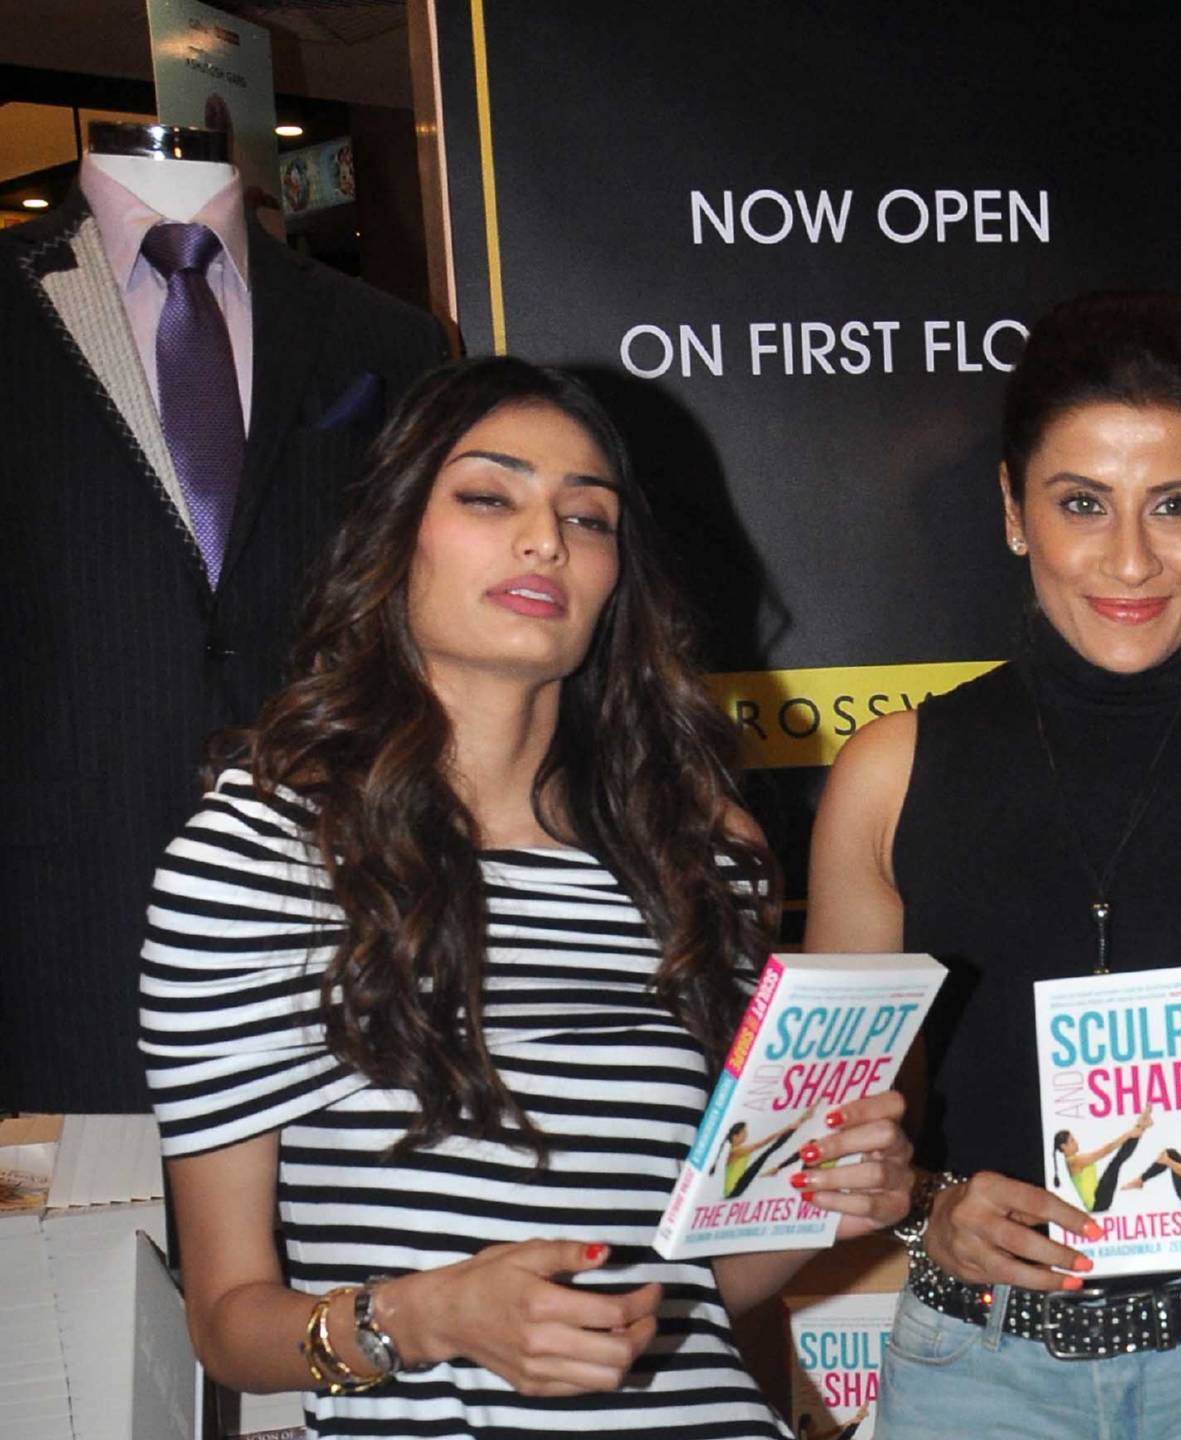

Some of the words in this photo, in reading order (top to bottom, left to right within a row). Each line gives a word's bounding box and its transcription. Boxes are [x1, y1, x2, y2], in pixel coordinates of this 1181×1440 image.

[690, 189, 853, 244] NOW
[877, 189, 1050, 243] OPEN
[620, 323, 723, 379] ON
[749, 320, 900, 376] FIRST
[765, 1003, 918, 1061] SCULPT
[1053, 1071, 1085, 1120] AND
[691, 1203, 727, 1230] THE
[725, 1198, 795, 1226] PILATES
